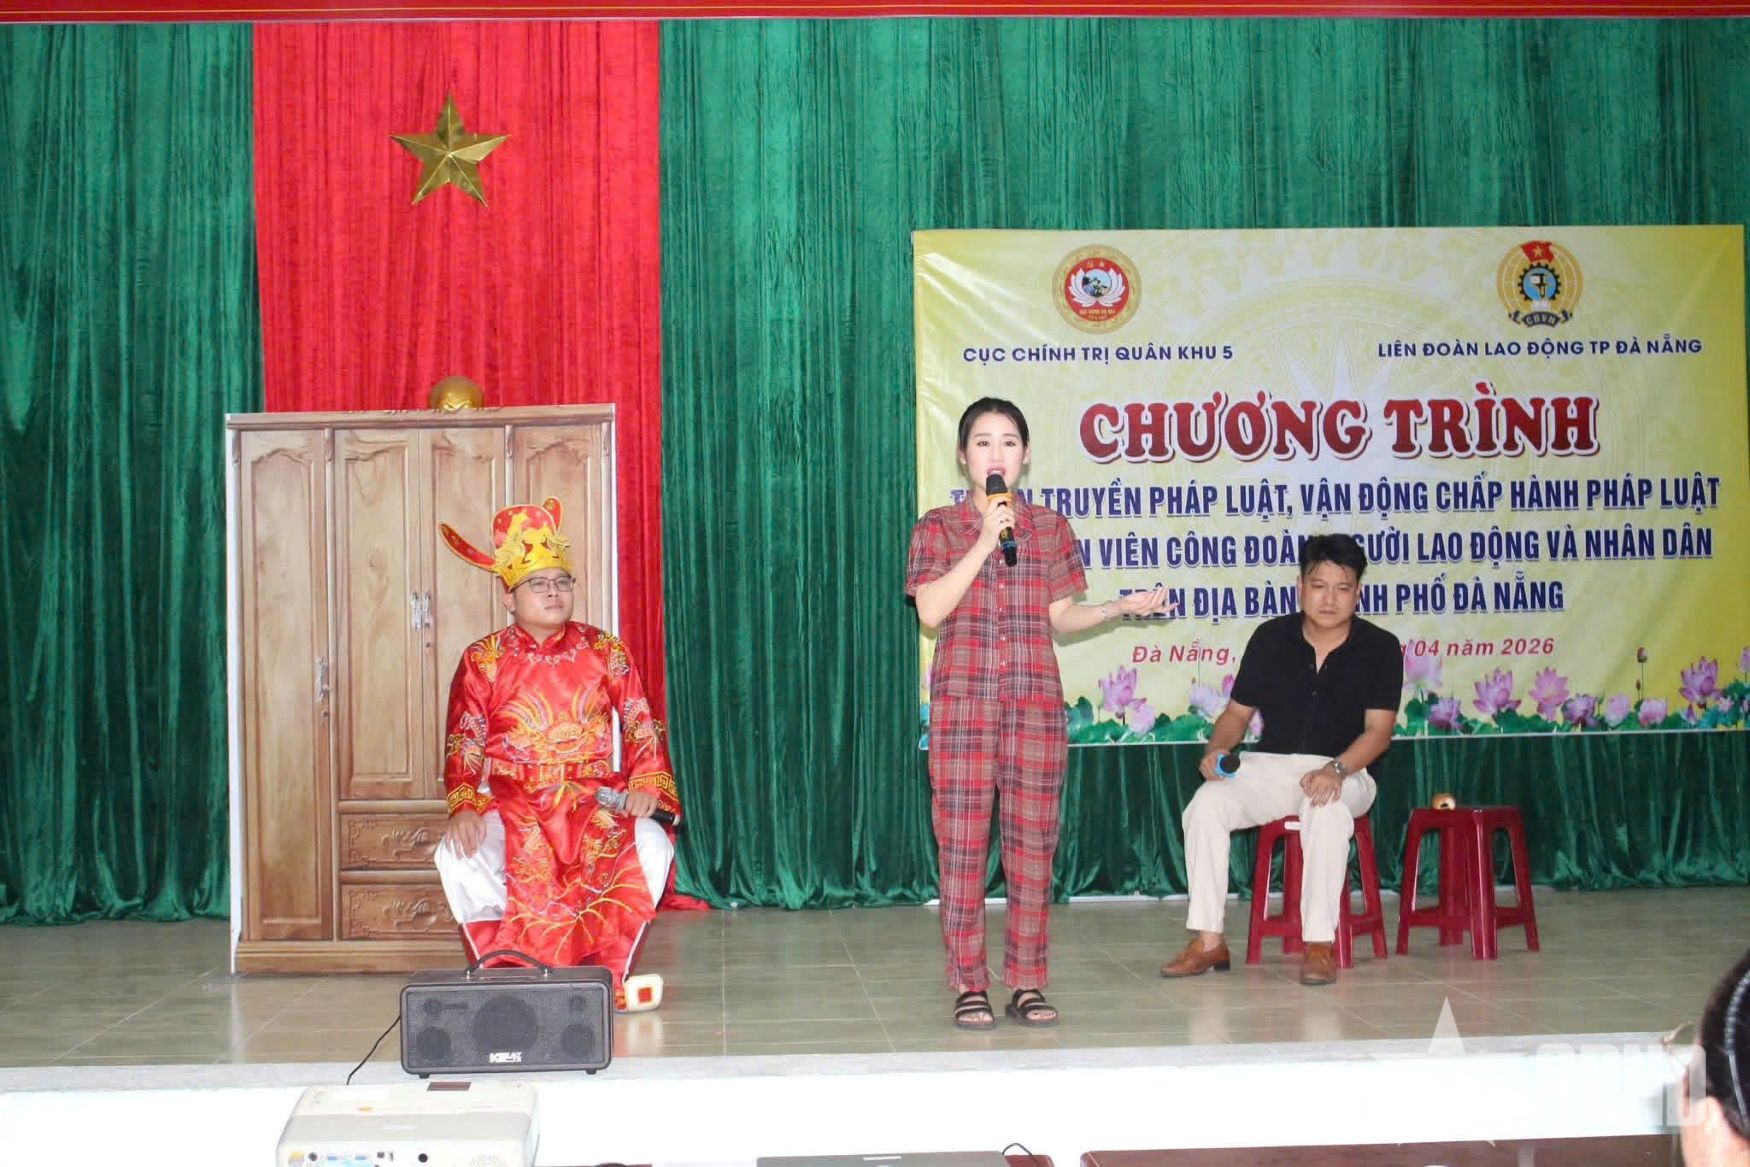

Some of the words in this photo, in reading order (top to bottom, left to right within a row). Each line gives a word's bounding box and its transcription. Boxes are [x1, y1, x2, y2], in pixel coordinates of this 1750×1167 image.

[963, 346, 1006, 367] CỤC
[1012, 343, 1076, 362] CHÍNH
[1082, 346, 1109, 365] TRỊ
[1115, 342, 1173, 361] QUÂN
[1178, 345, 1217, 360] KHU
[1223, 345, 1234, 360] 5
[1378, 339, 1417, 357] LIÊN
[1423, 338, 1479, 357] ĐOÀN
[1484, 342, 1522, 356] LAO
[1527, 337, 1584, 360] ĐỘNG
[1590, 341, 1610, 355] TP
[1615, 337, 1642, 355] ĐÀ
[1647, 332, 1703, 354] NẴNG
[1080, 390, 1367, 458] CHƯƠNG
[1383, 381, 1594, 454] TRÌNH
[1041, 477, 1142, 517] TRUYỀN
[1150, 479, 1218, 515] PHÁP
[1226, 477, 1293, 521] LUẬT,
[1300, 475, 1351, 519] VẬN
[1359, 476, 1429, 519] ĐỘNG
[1436, 471, 1503, 511] CHẤP
[1510, 473, 1579, 510] HÀNH
[1587, 473, 1653, 508] PHÁP
[1660, 472, 1720, 512] LUẬT
[1100, 531, 1159, 567] VIÊN
[1167, 531, 1237, 567] CÔNG
[1417, 532, 1463, 562] LAO
[1471, 526, 1540, 566] ĐỘNG
[1547, 524, 1579, 560] VÀ
[1585, 523, 1656, 560] NHÂN
[1663, 521, 1713, 558] DÂN
[1192, 587, 1238, 622] ĐỊA
[1244, 580, 1297, 618] BÀN
[1397, 573, 1447, 613] PHỐ
[1453, 575, 1487, 612] ĐÀ
[1494, 570, 1565, 612] NẴNG
[1132, 645, 1161, 663] Đà
[1414, 639, 1440, 657] 04
[1446, 638, 1495, 656] năm
[1501, 637, 1555, 656] 2026
